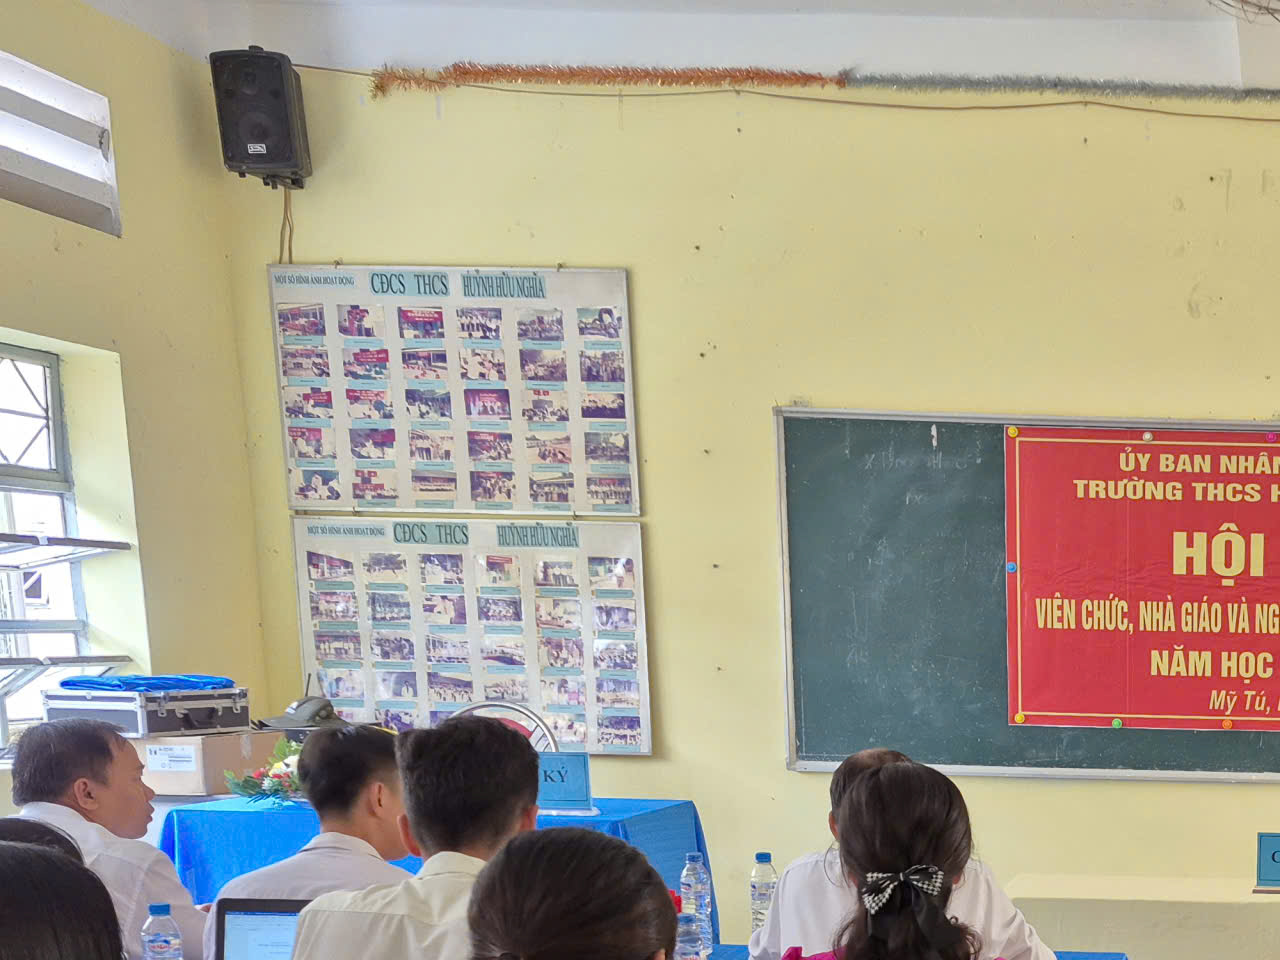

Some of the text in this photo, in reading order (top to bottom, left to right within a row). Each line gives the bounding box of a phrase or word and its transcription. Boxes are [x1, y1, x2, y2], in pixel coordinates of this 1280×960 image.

[371, 273, 448, 296] CĐCS THCS
[1119, 447, 1151, 472] ỦY
[1159, 453, 1211, 473] BAN
[1072, 476, 1183, 501] TRƯỜNG
[1191, 482, 1261, 502] THCS
[393, 523, 469, 545] CĐCS THCS
[1172, 522, 1265, 587] HỘI
[1035, 591, 1076, 630] VIÊN
[1081, 593, 1134, 635] CHỨC,
[1139, 595, 1176, 632] NHÀ
[1181, 595, 1222, 633] GIÁO
[1227, 596, 1250, 634] VÀ
[1150, 644, 1212, 677] NĂM
[1220, 651, 1274, 684] HỌC
[1209, 689, 1238, 716] Mỹ
[1243, 690, 1271, 715] Tú,
[543, 766, 568, 783] KÝ
